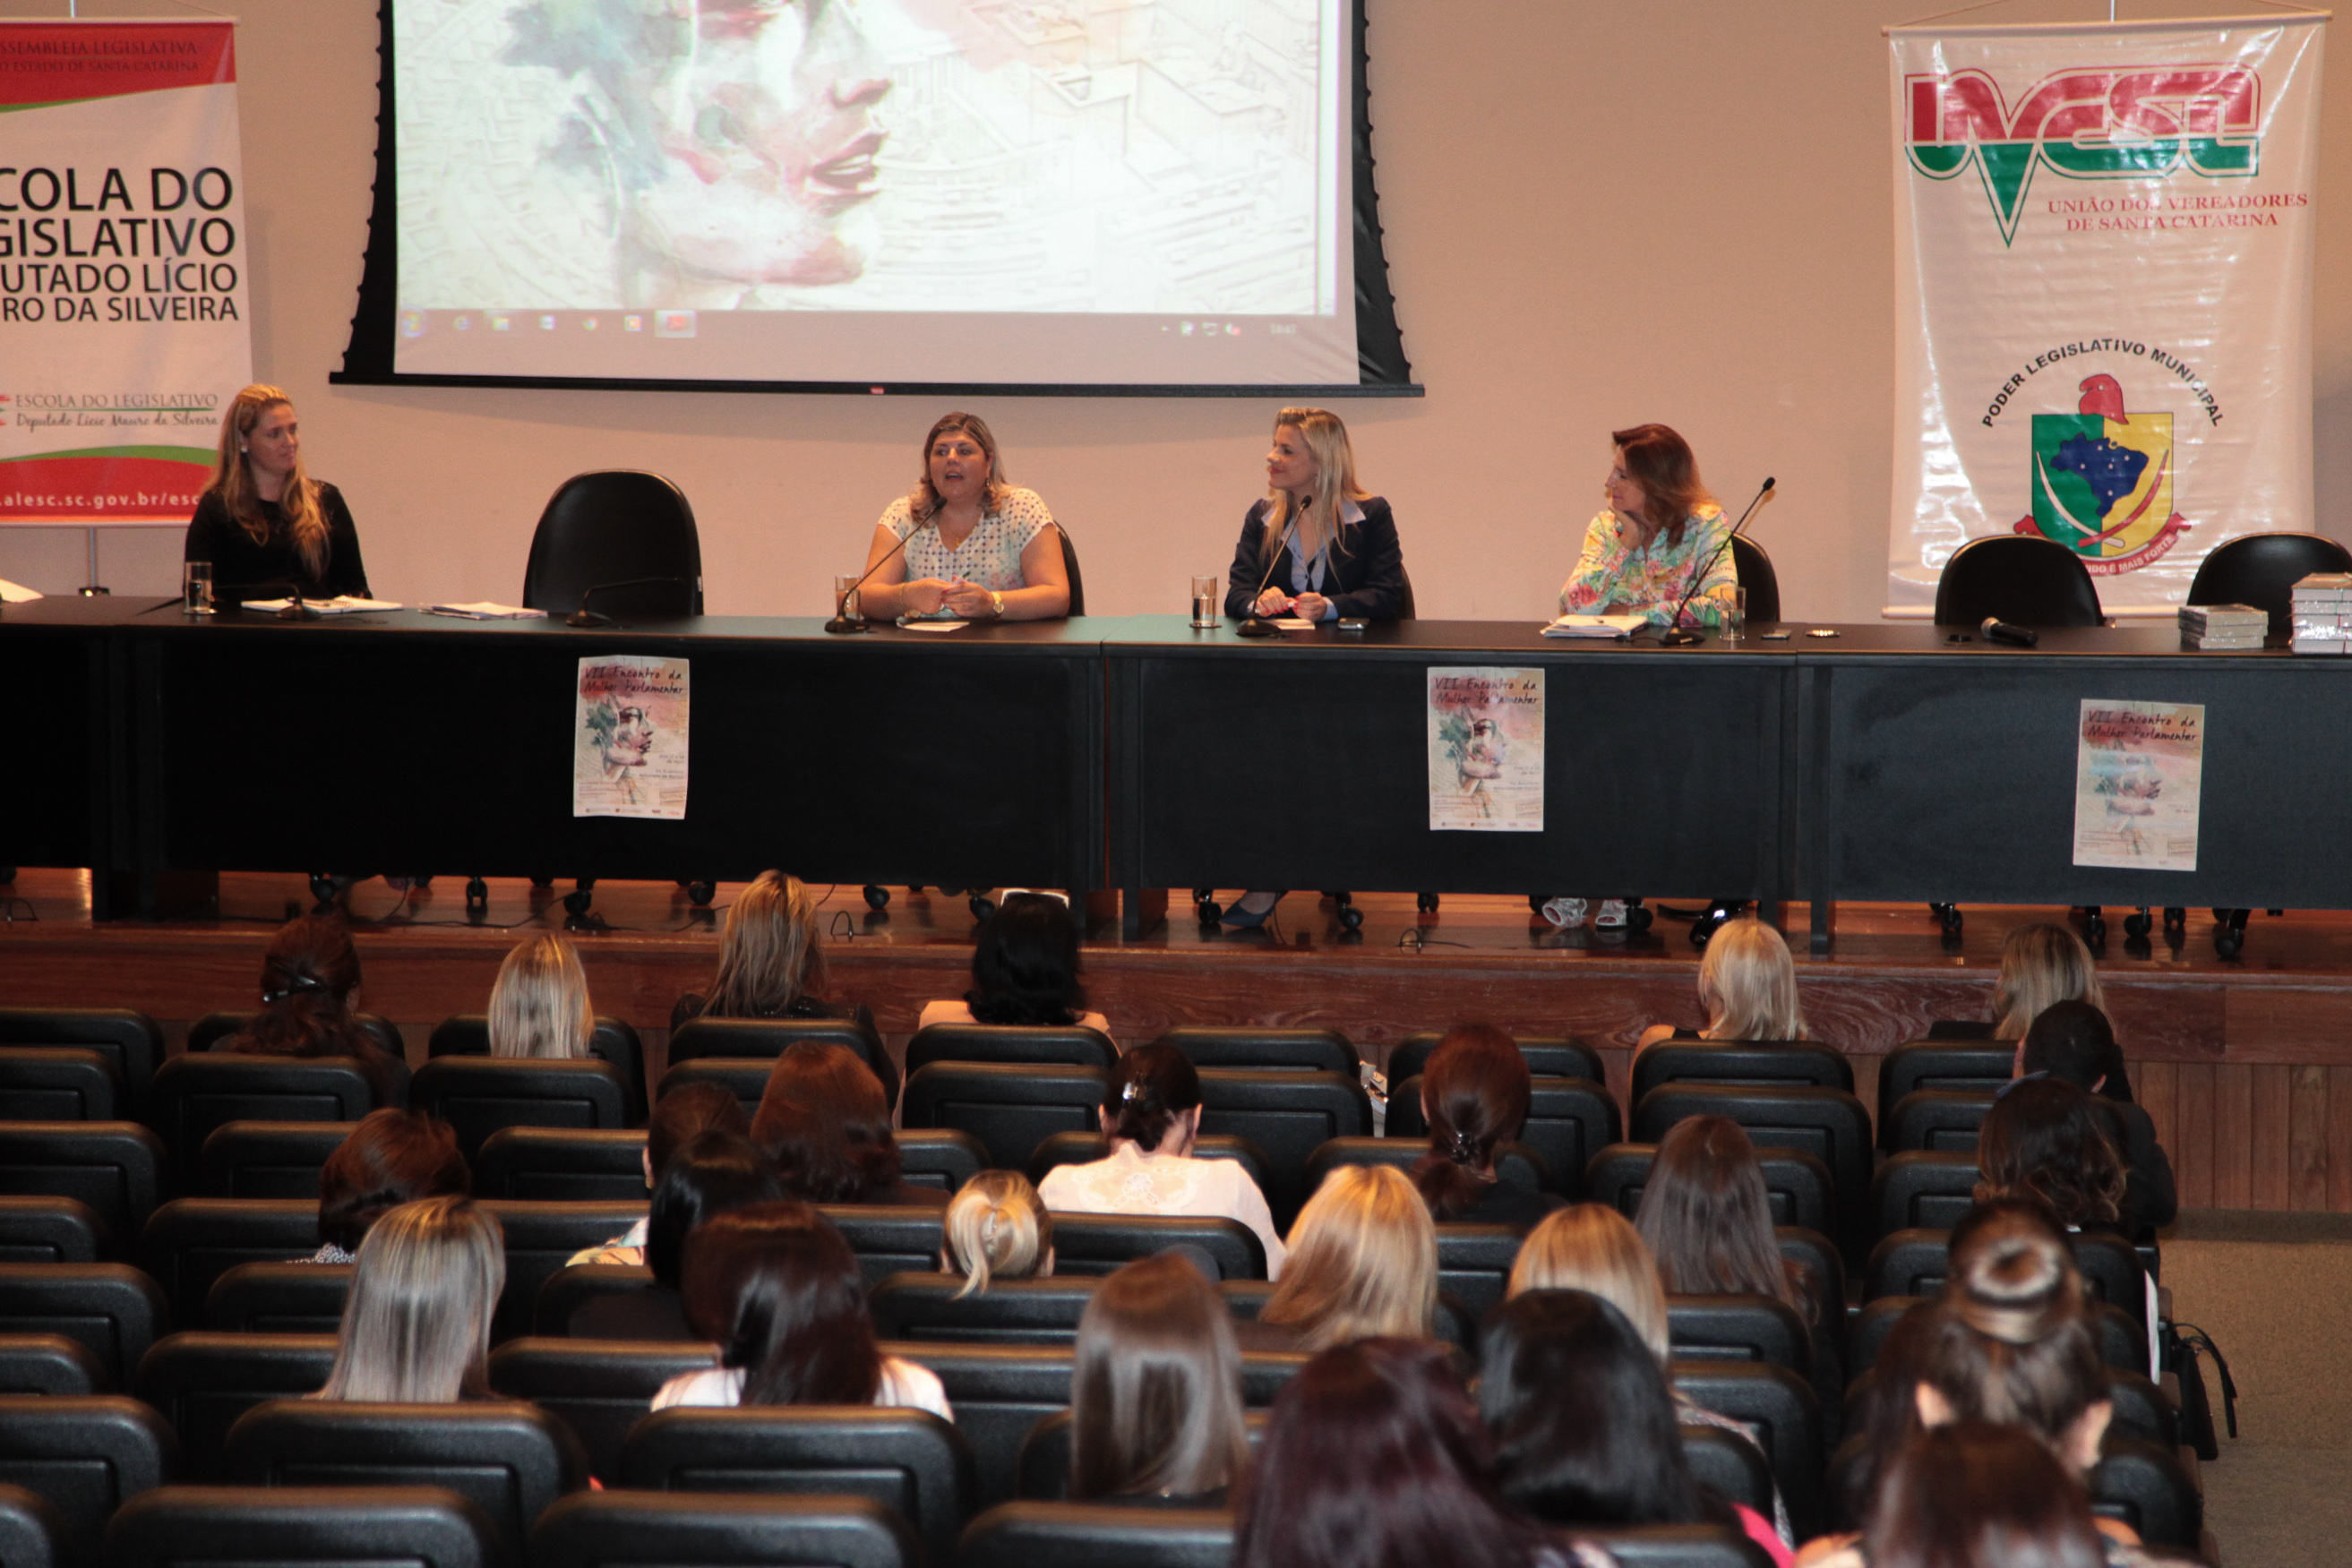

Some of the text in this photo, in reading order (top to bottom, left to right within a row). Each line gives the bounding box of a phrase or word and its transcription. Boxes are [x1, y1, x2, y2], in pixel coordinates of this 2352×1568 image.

[94, 40, 198, 55] LEGISLATIVA
[68, 62, 84, 72] DE
[90, 62, 128, 73] SANTA
[133, 62, 199, 72] CATARINA
[150, 167, 233, 211] DO
[2048, 196, 2115, 213] UNIÃO
[2167, 193, 2309, 210] VEREADORES
[2066, 213, 2279, 231] DE SANTA CATARINA
[1, 257, 238, 294] UTADO LÍCIO
[3, 296, 239, 321] RO DA SILVEIRA
[1982, 338, 2224, 428] PODER LEGISLATIVO MUNICIPAL
[16, 393, 219, 408] ESCOLA DO LEGISLATIVO
[154, 413, 168, 426] da
[2118, 557, 2144, 571] MAIS
[2144, 535, 2175, 561] FORTE
[1523, 679, 1537, 691] da
[2180, 715, 2196, 728] da
